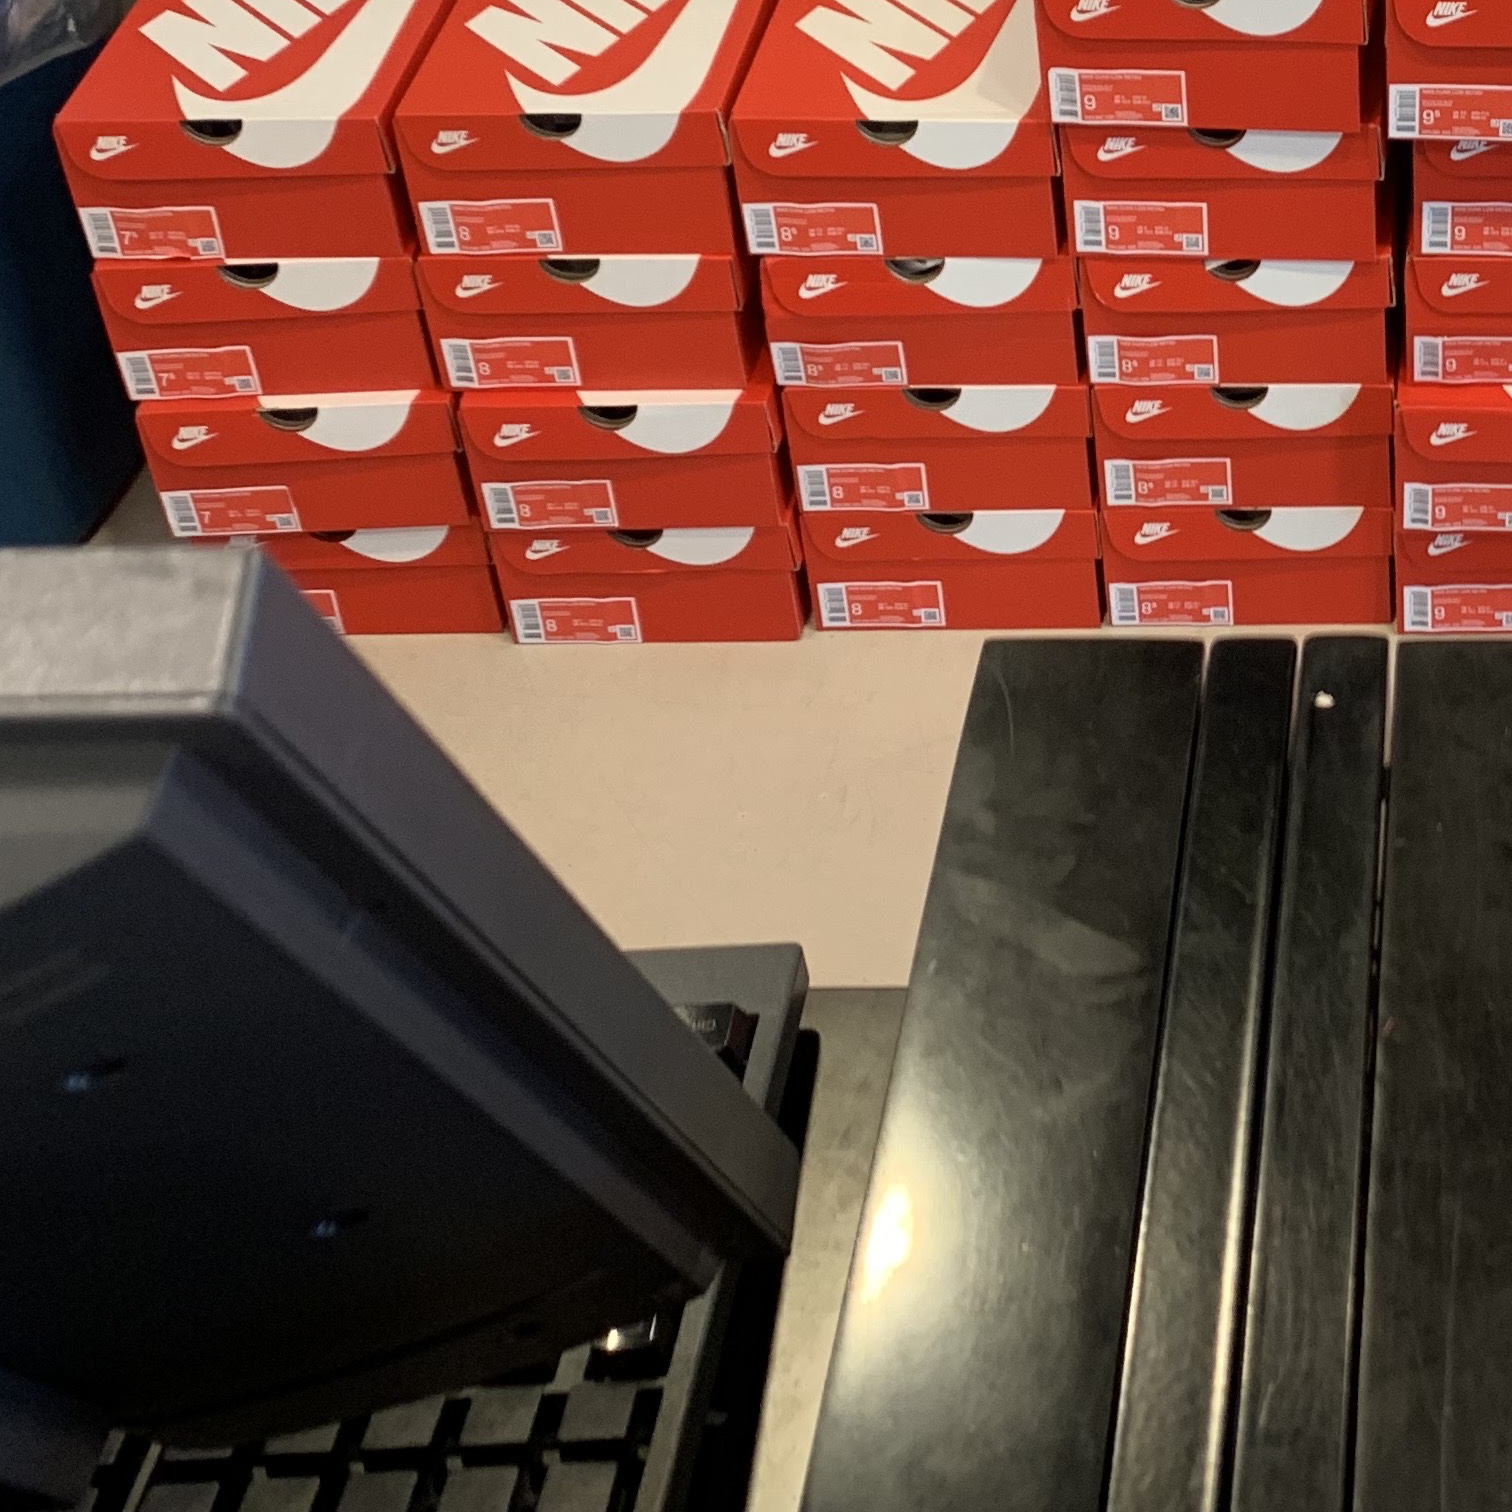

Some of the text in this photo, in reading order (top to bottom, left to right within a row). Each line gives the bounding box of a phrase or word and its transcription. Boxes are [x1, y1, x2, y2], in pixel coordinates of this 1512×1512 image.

[1084, 95, 1096, 110] 9
[459, 226, 471, 241] 8
[1108, 225, 1120, 240] 9
[1454, 225, 1466, 240] 9
[478, 362, 491, 375] 8
[851, 603, 862, 616] 8
[545, 618, 558, 633] 8
